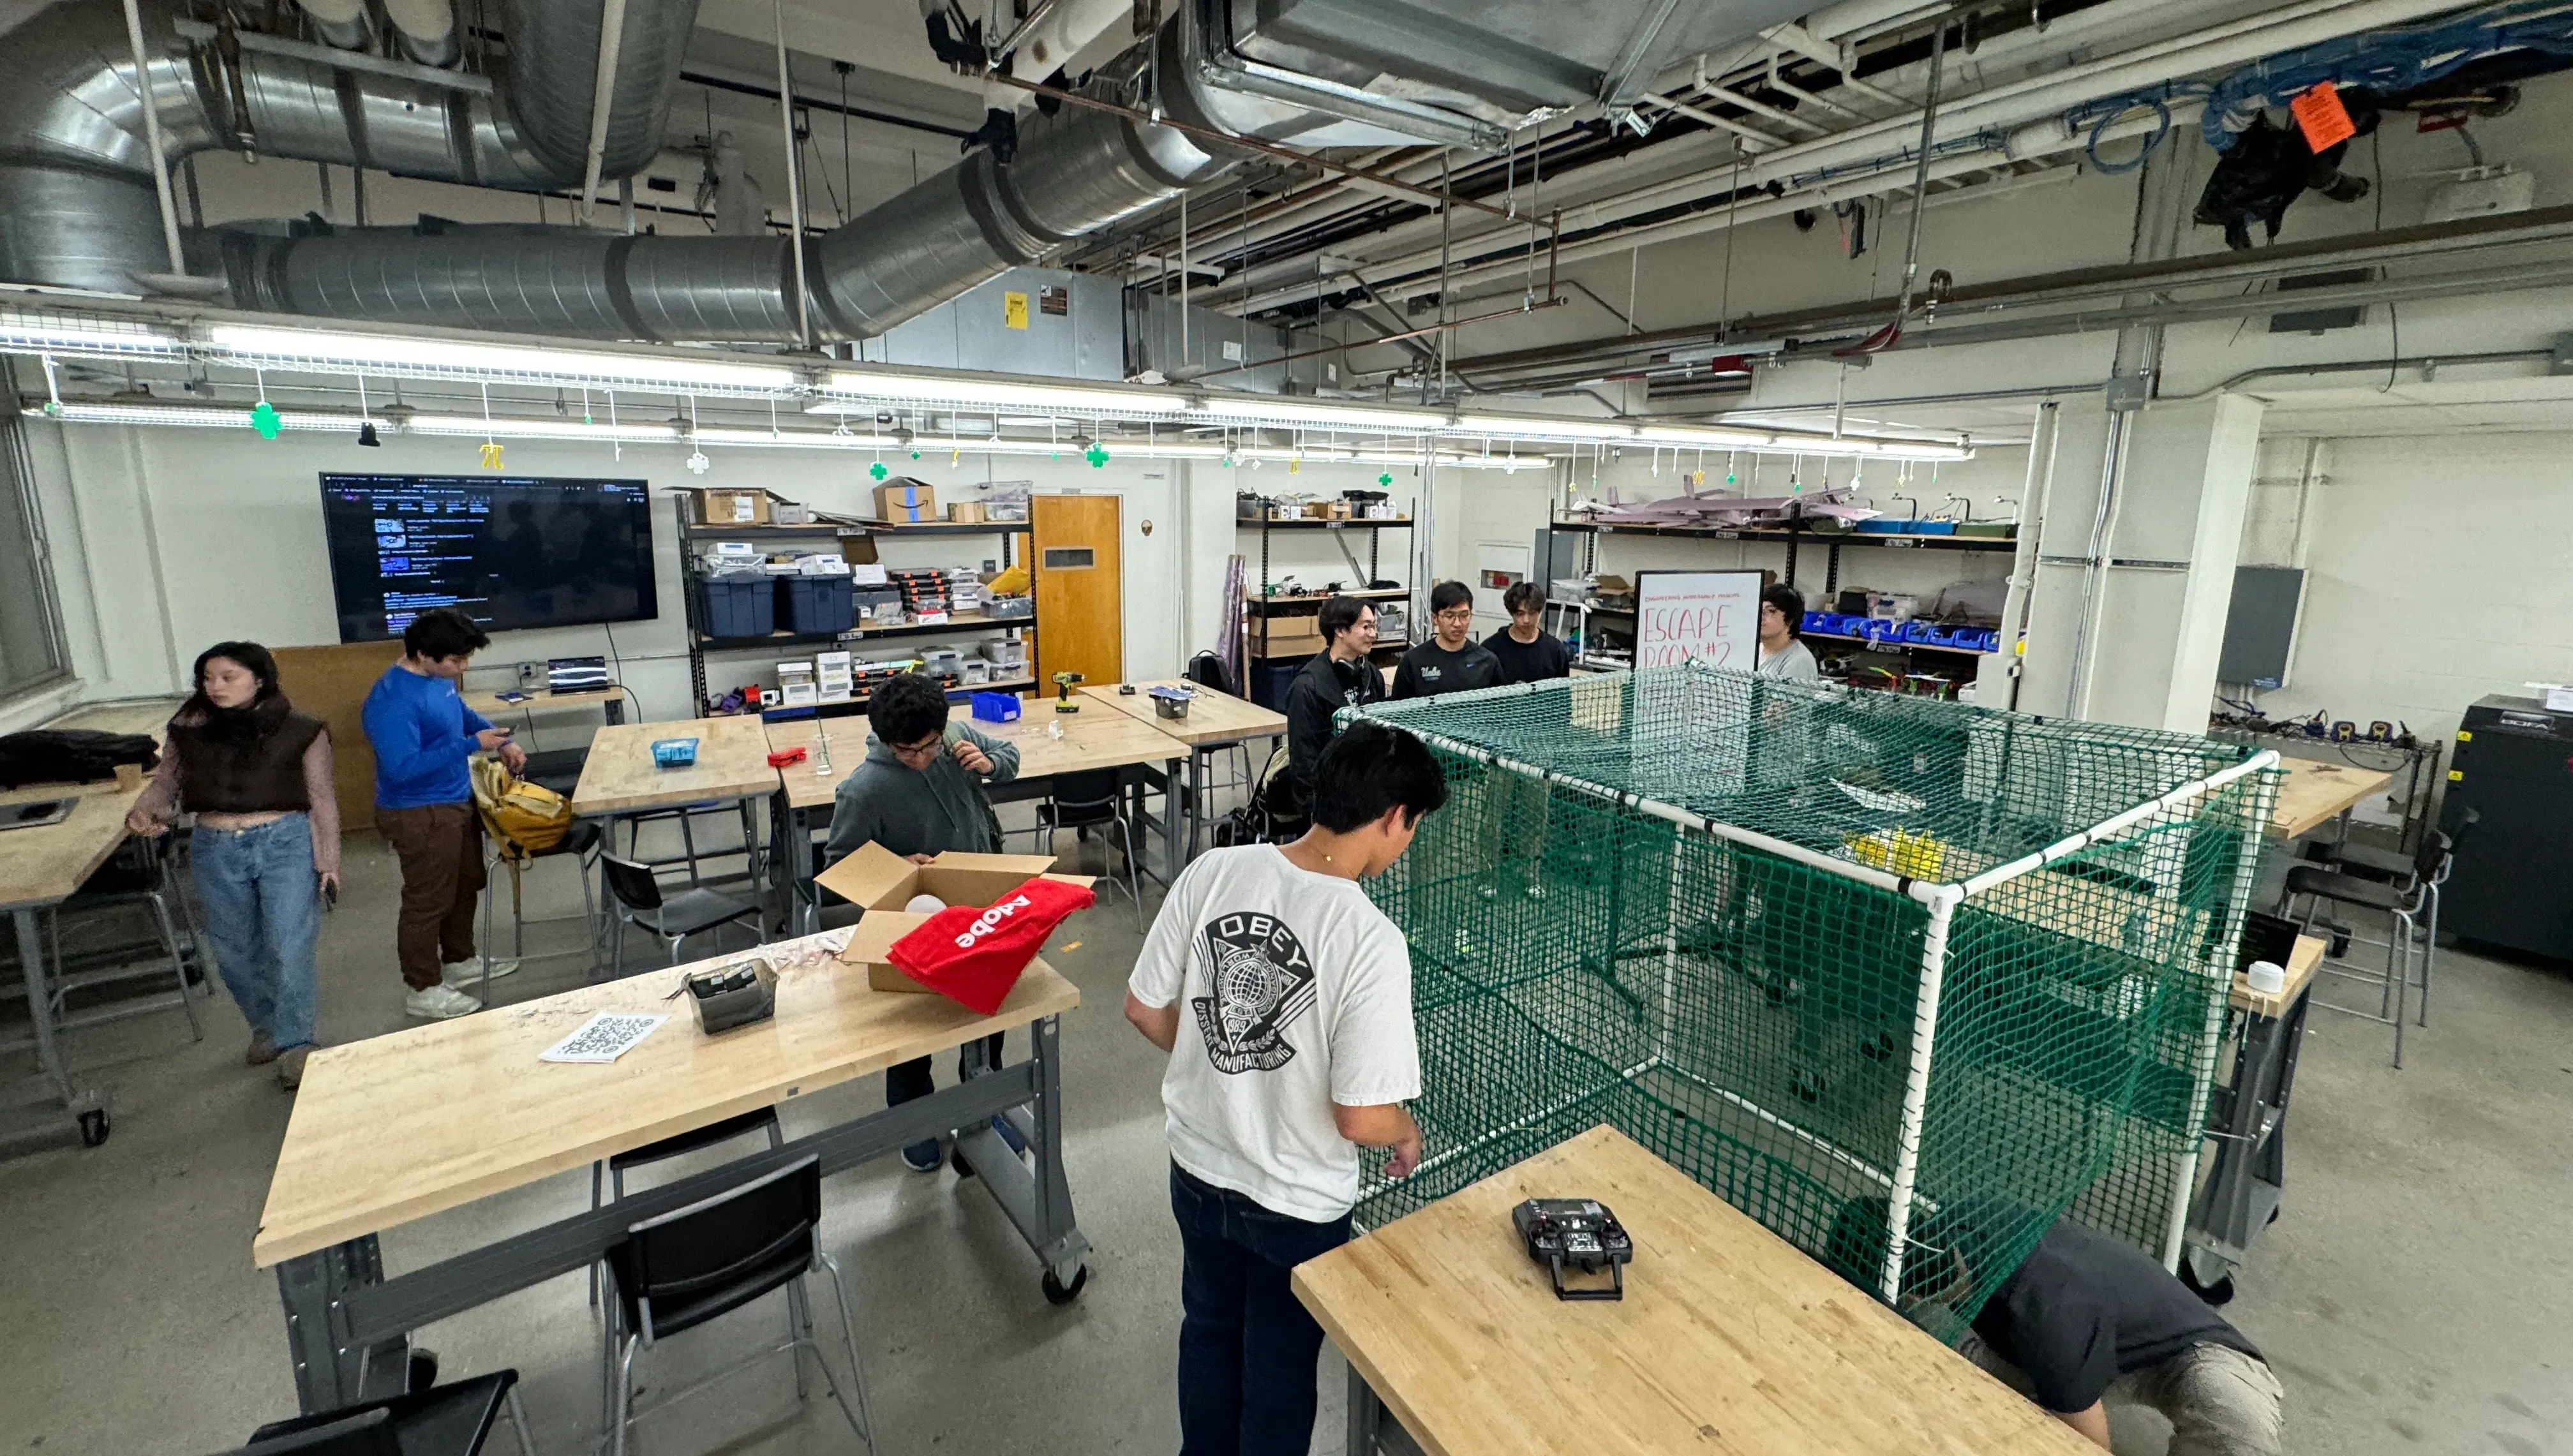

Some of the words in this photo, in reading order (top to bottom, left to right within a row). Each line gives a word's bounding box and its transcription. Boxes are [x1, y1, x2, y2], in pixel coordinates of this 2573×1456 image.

[1644, 604, 1732, 643] ESCAPE
[955, 895, 1031, 948] Adobe
[1219, 915, 1308, 968] OBEY
[1195, 1001, 1214, 1048] DISSENT
[1211, 1043, 1292, 1072] MANUFACTURING
[1228, 1019, 1247, 1033] 1989
